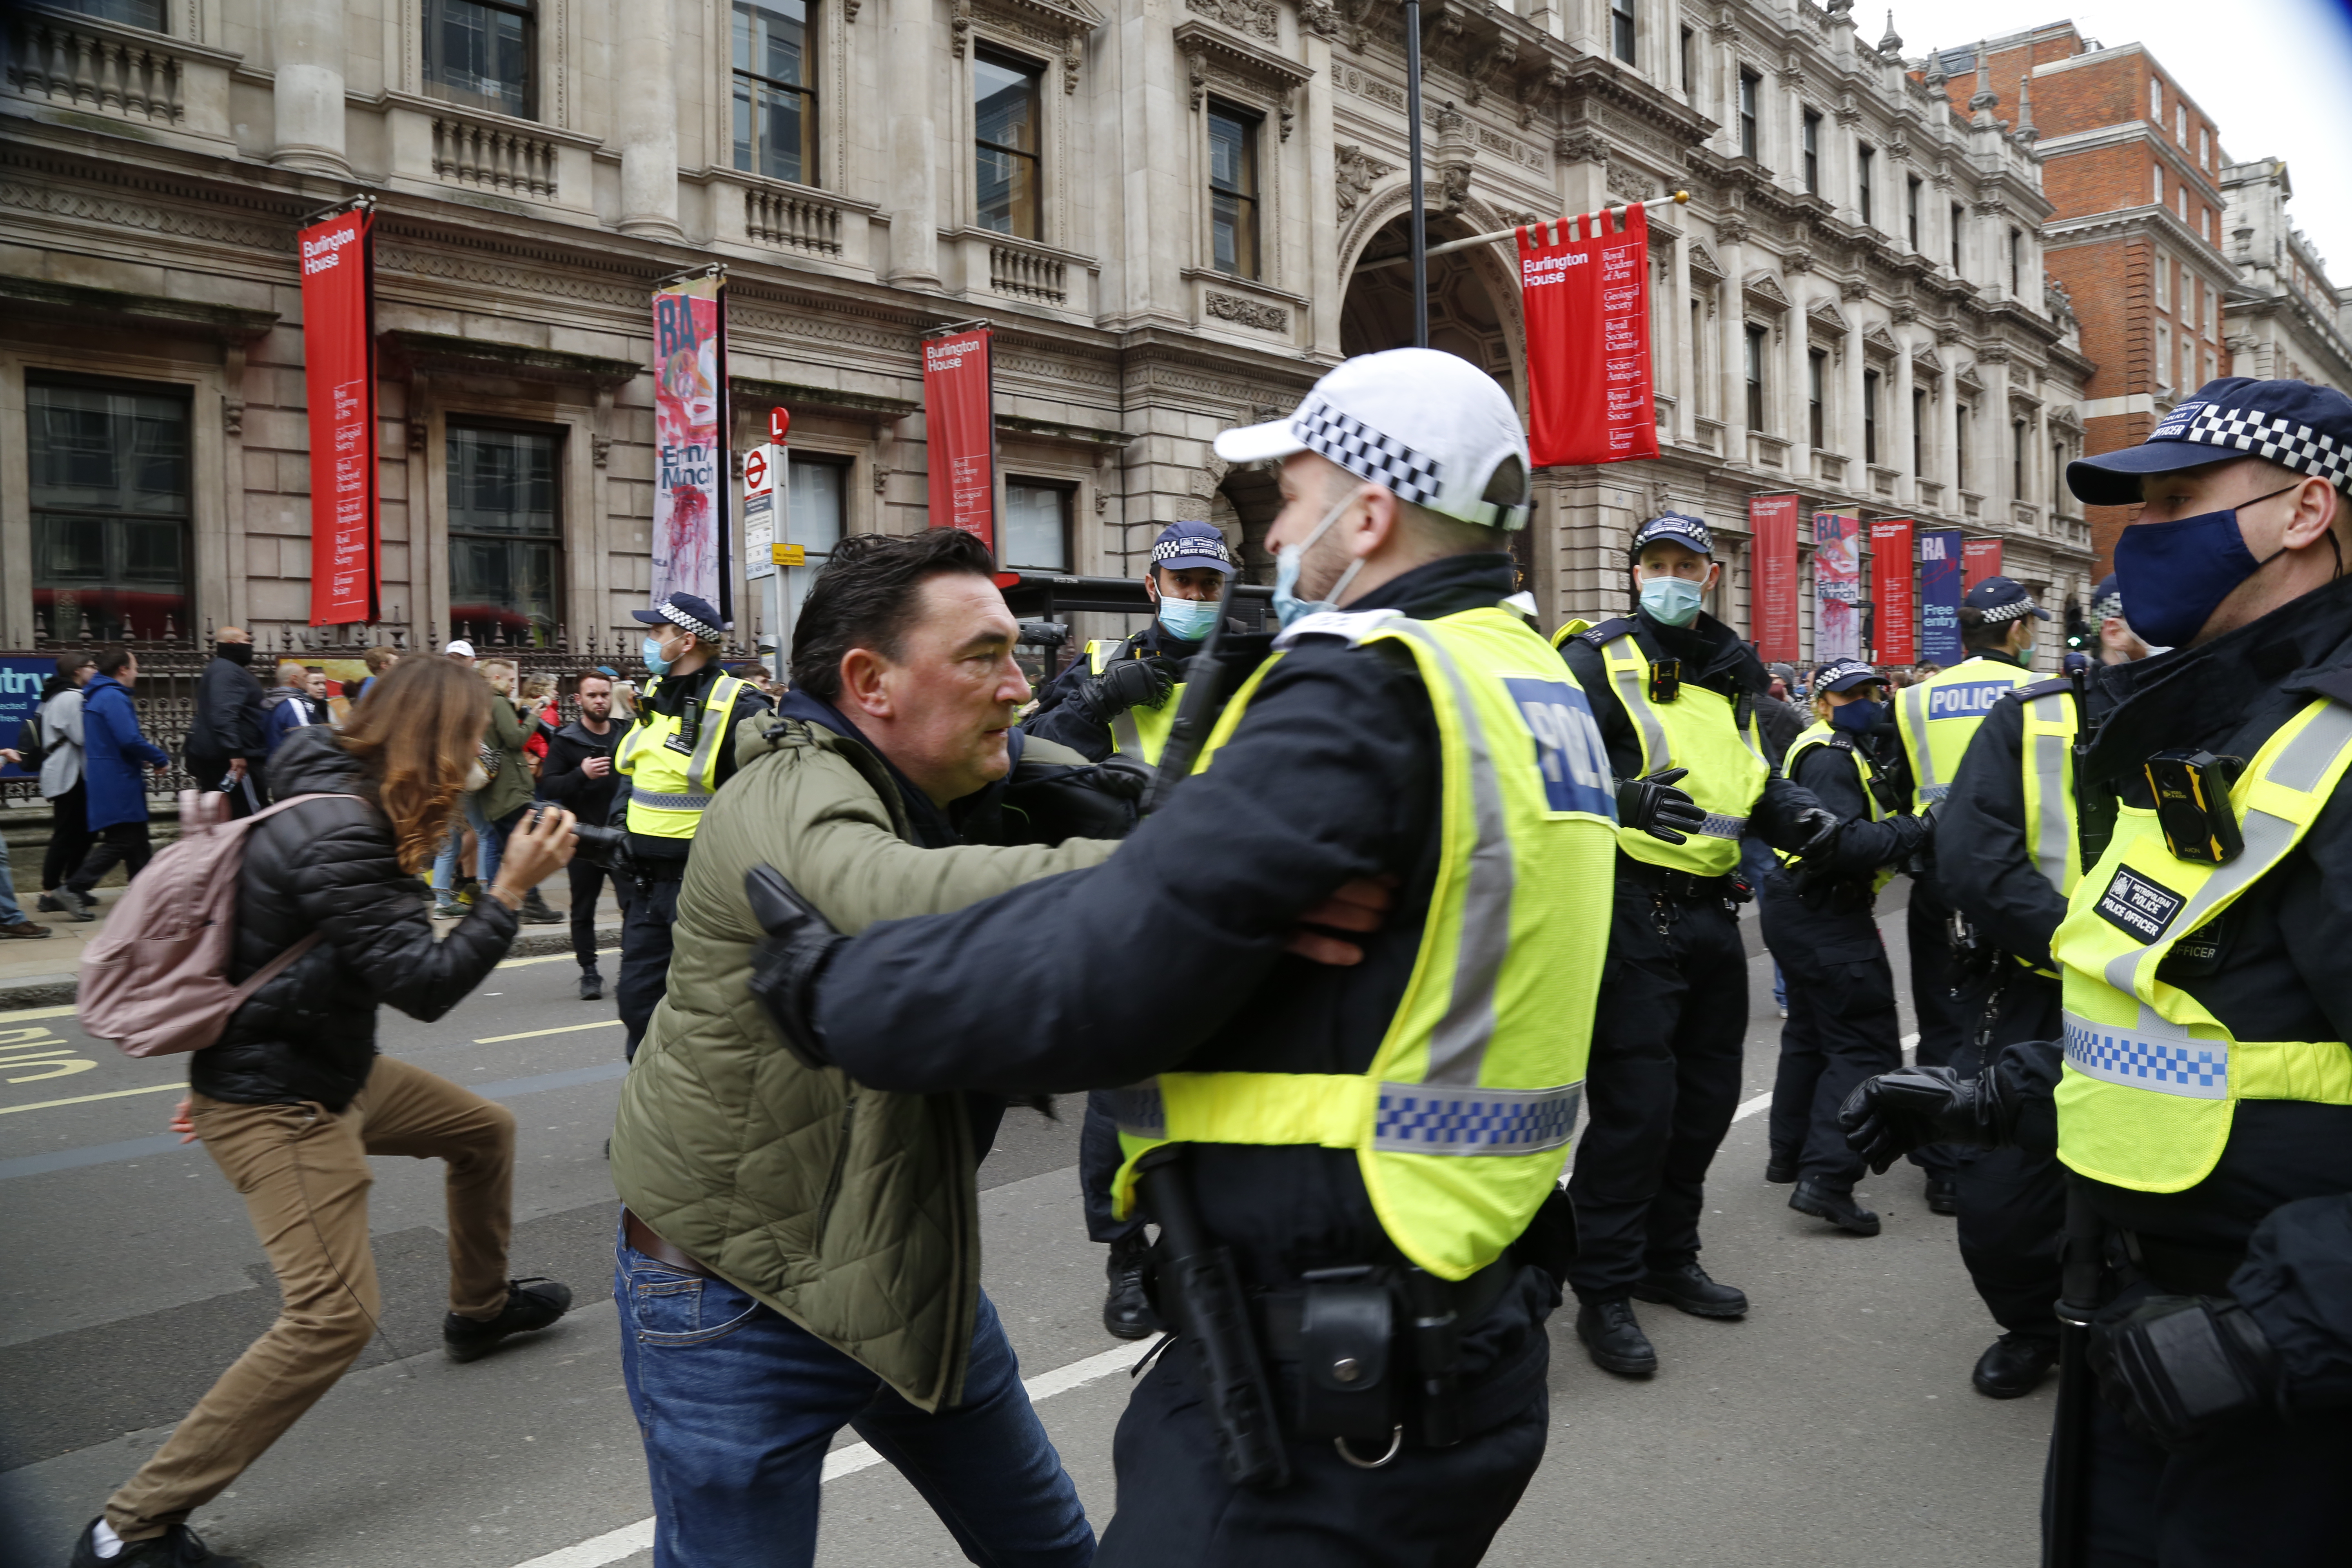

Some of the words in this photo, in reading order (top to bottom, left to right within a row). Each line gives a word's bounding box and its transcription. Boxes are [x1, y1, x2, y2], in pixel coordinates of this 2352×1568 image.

[303, 228, 355, 258] Burlington
[305, 253, 339, 275] House
[1523, 253, 1588, 273] Burlington
[1602, 249, 1625, 262] Royal
[1523, 272, 1566, 287] House
[1603, 271, 1613, 281] of
[1612, 270, 1630, 279] Arts
[1604, 301, 1633, 311] Society
[659, 294, 697, 357] RA
[1605, 320, 1628, 332] Royal
[927, 340, 979, 359] Burlington
[928, 358, 962, 372] House
[1607, 390, 1630, 402] Royal
[772, 413, 782, 436] L
[1817, 515, 1842, 541] RA
[1922, 537, 1947, 560] RA
[1924, 604, 1955, 615] Free
[1924, 616, 1958, 628] entry
[2131, 893, 2161, 914] POLICE
[2132, 883, 2172, 908] METROPOLITAN
[2101, 897, 2127, 917] POLICE
[2124, 910, 2159, 936] OFFICER
